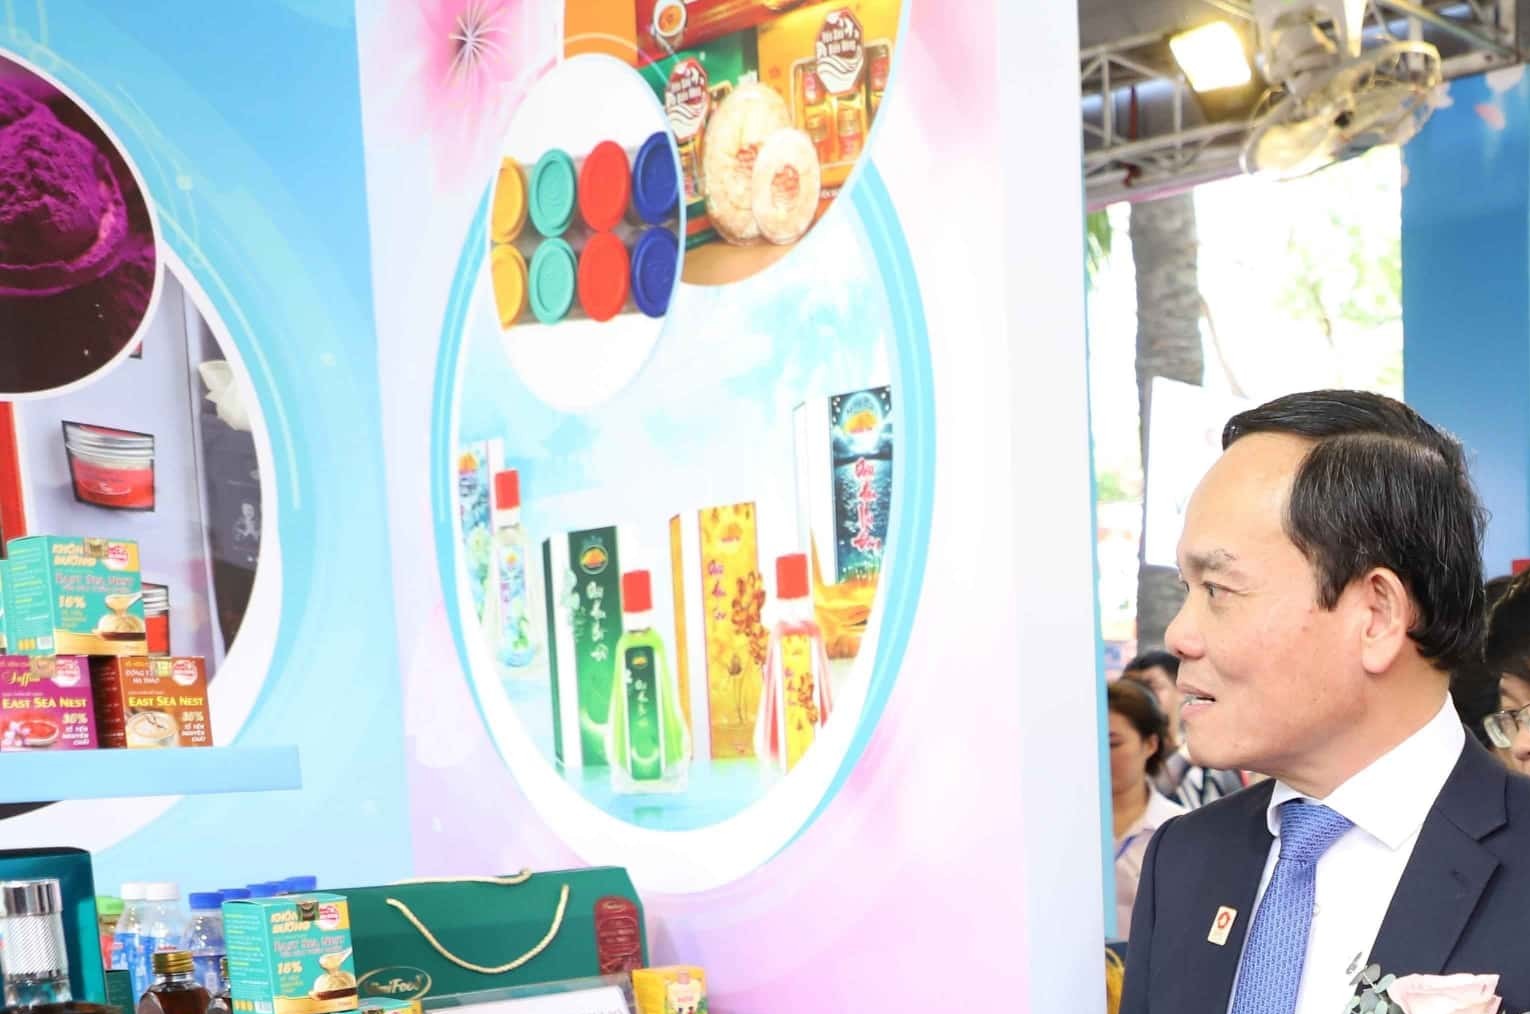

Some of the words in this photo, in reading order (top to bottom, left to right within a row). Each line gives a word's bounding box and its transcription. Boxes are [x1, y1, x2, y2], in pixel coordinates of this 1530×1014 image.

[3, 698, 30, 709] EAST
[33, 696, 56, 708] SEA
[60, 697, 86, 708] NEST
[128, 697, 154, 707] EAST
[156, 695, 177, 706] SEA
[180, 696, 203, 706] NEST
